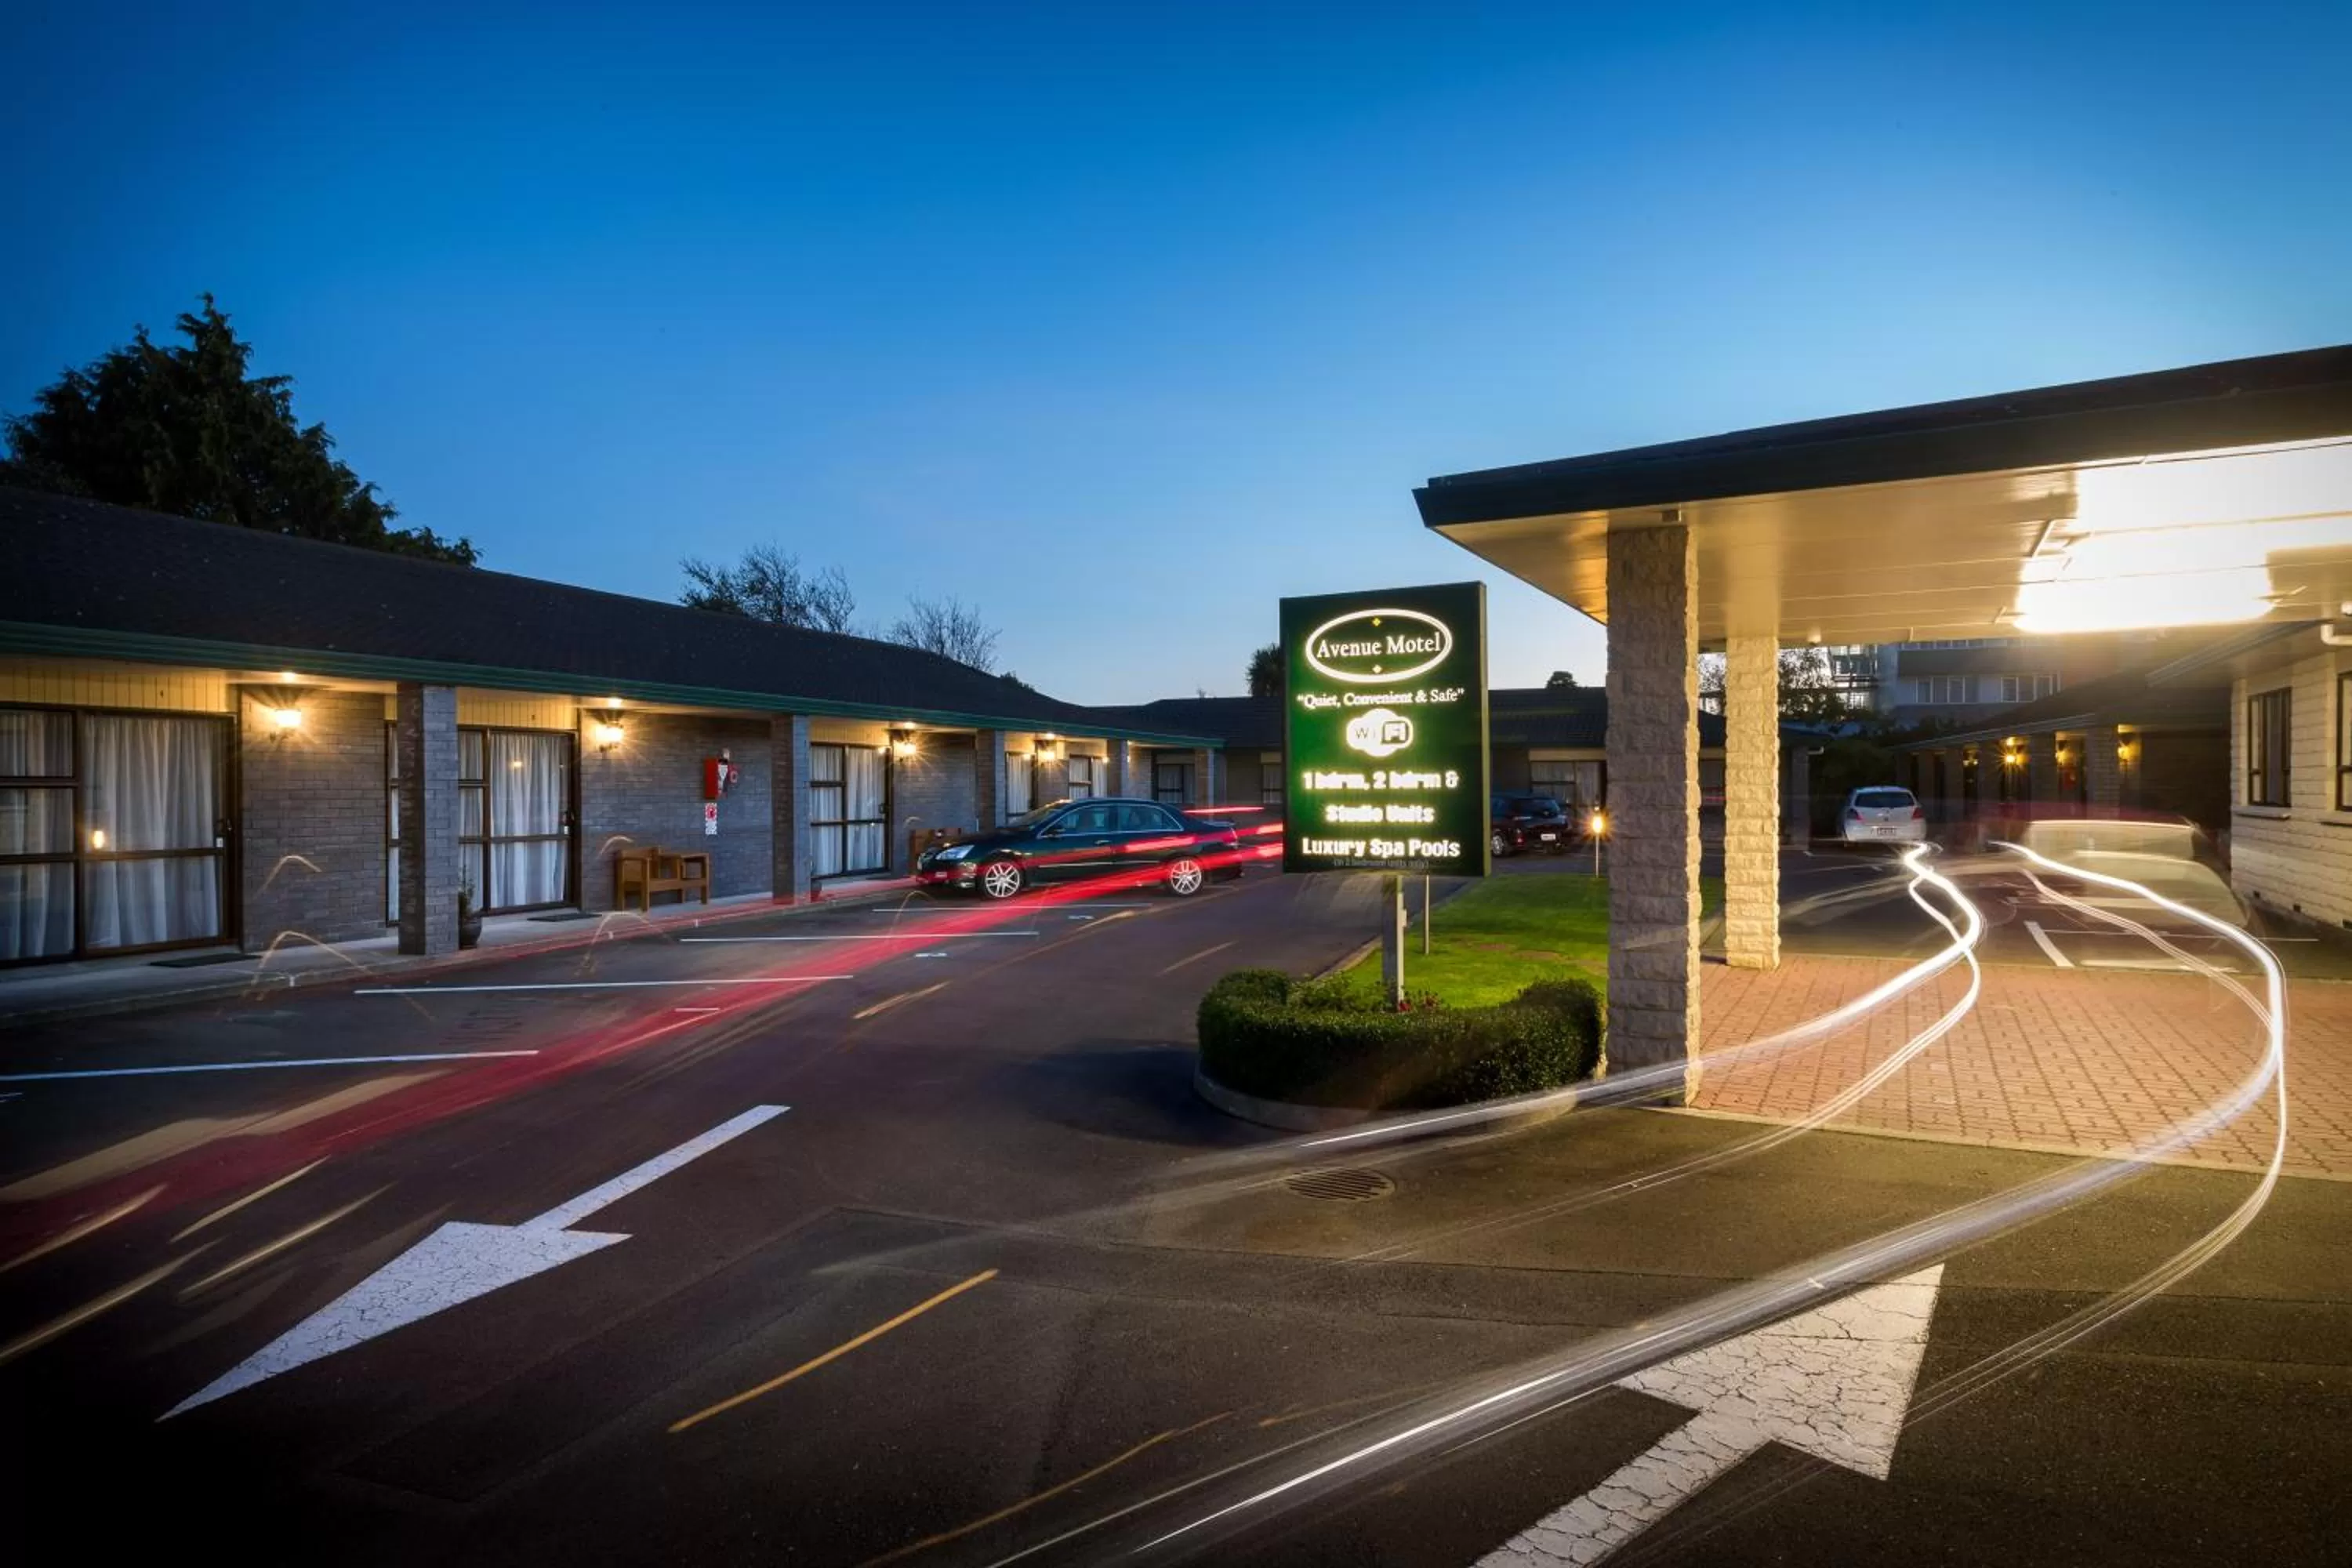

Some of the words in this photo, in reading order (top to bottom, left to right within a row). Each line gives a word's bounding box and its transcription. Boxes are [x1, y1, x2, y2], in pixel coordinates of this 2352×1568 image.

[1316, 639, 1382, 658] Avenue
[1386, 632, 1440, 655] Motel
[1415, 689, 1427, 702] &
[1303, 772, 1313, 789] 1
[1373, 771, 1387, 789] 2
[1445, 770, 1459, 788] &
[1302, 837, 1367, 858] Luxury
[1370, 838, 1406, 858] Spa
[1408, 839, 1461, 857] Pools
